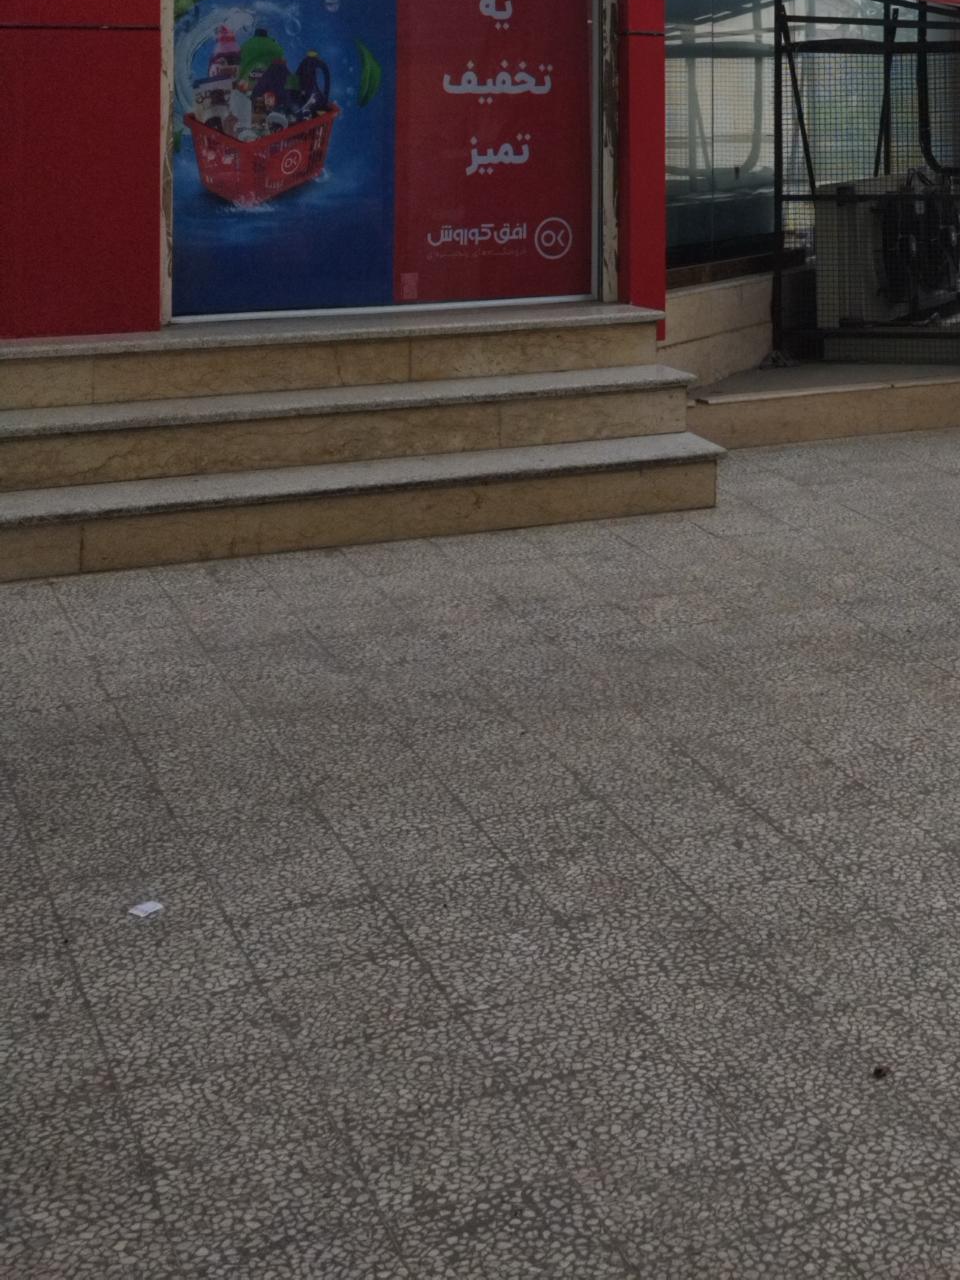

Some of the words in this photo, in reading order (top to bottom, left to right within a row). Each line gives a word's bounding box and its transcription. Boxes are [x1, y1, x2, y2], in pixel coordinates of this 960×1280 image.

[443, 60, 553, 104] تخفیف
[466, 133, 531, 175] تمیز
[427, 223, 494, 247] کوروش
[494, 223, 527, 245] افق
